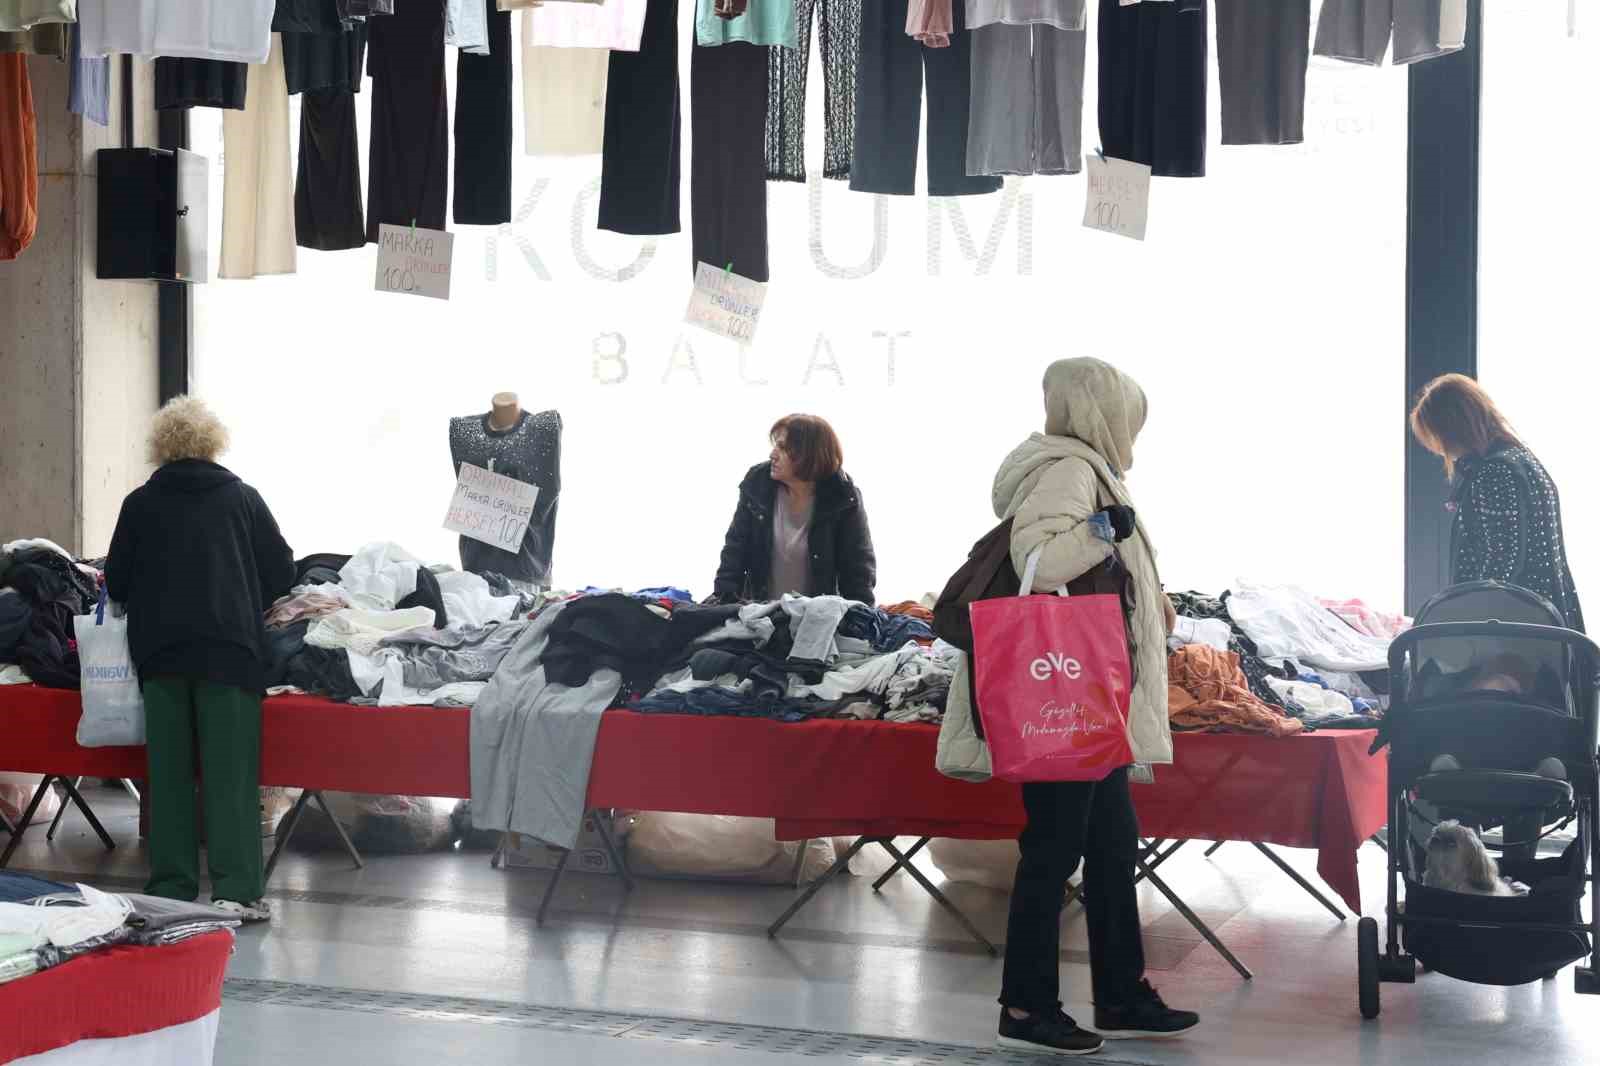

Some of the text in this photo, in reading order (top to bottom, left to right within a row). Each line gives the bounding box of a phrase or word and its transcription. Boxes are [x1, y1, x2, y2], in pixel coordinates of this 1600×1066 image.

[1094, 200, 1121, 230] 100
[382, 231, 434, 257] MARKA
[384, 265, 415, 291] 100
[592, 331, 912, 386] BALAT
[456, 482, 489, 506] MARKA
